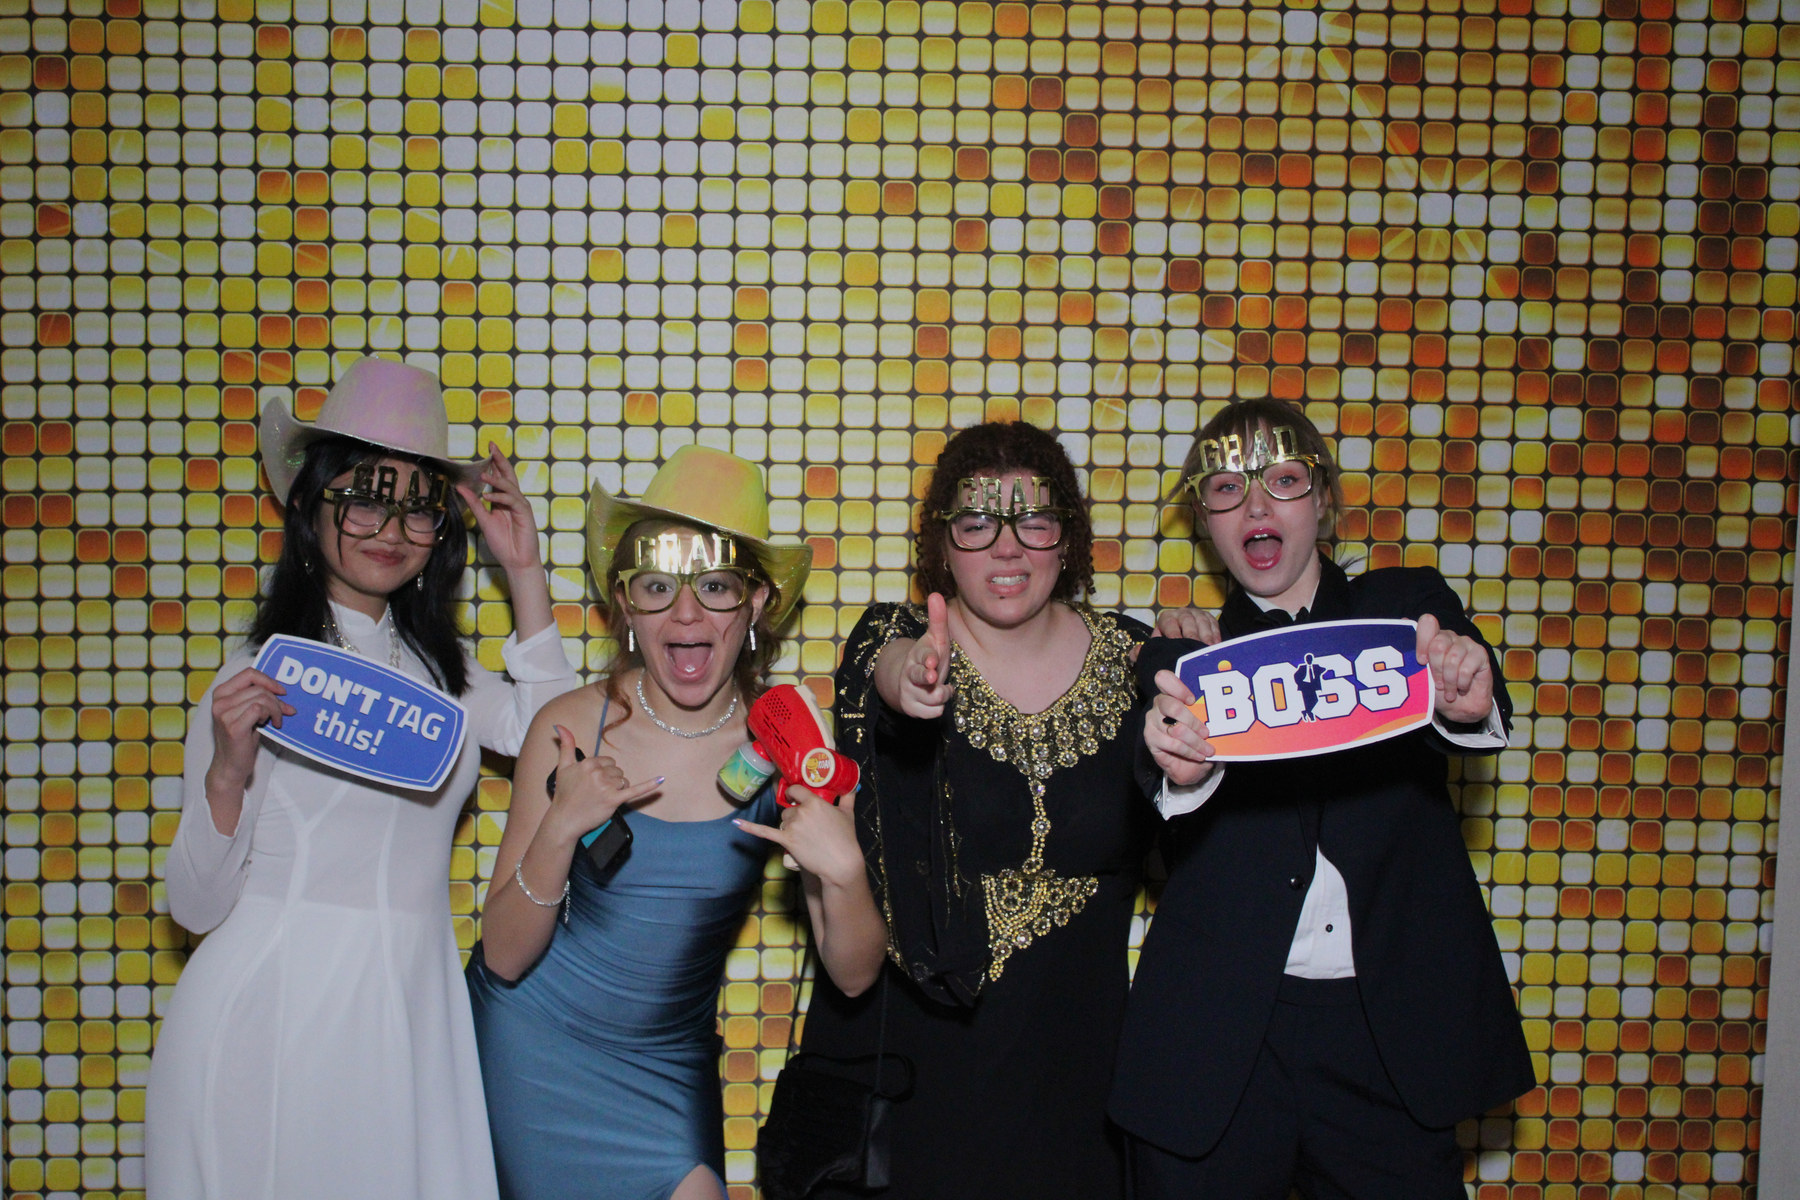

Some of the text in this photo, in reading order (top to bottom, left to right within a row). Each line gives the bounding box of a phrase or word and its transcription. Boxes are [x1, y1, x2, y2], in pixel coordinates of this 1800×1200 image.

[1200, 425, 1298, 472] GRAD
[353, 463, 448, 507] GRAD
[958, 476, 1053, 514] GRAD
[634, 532, 737, 574] GRAD
[275, 655, 446, 742] DON'T TAG
[1199, 645, 1410, 738] BOSS
[313, 708, 385, 755] this!
